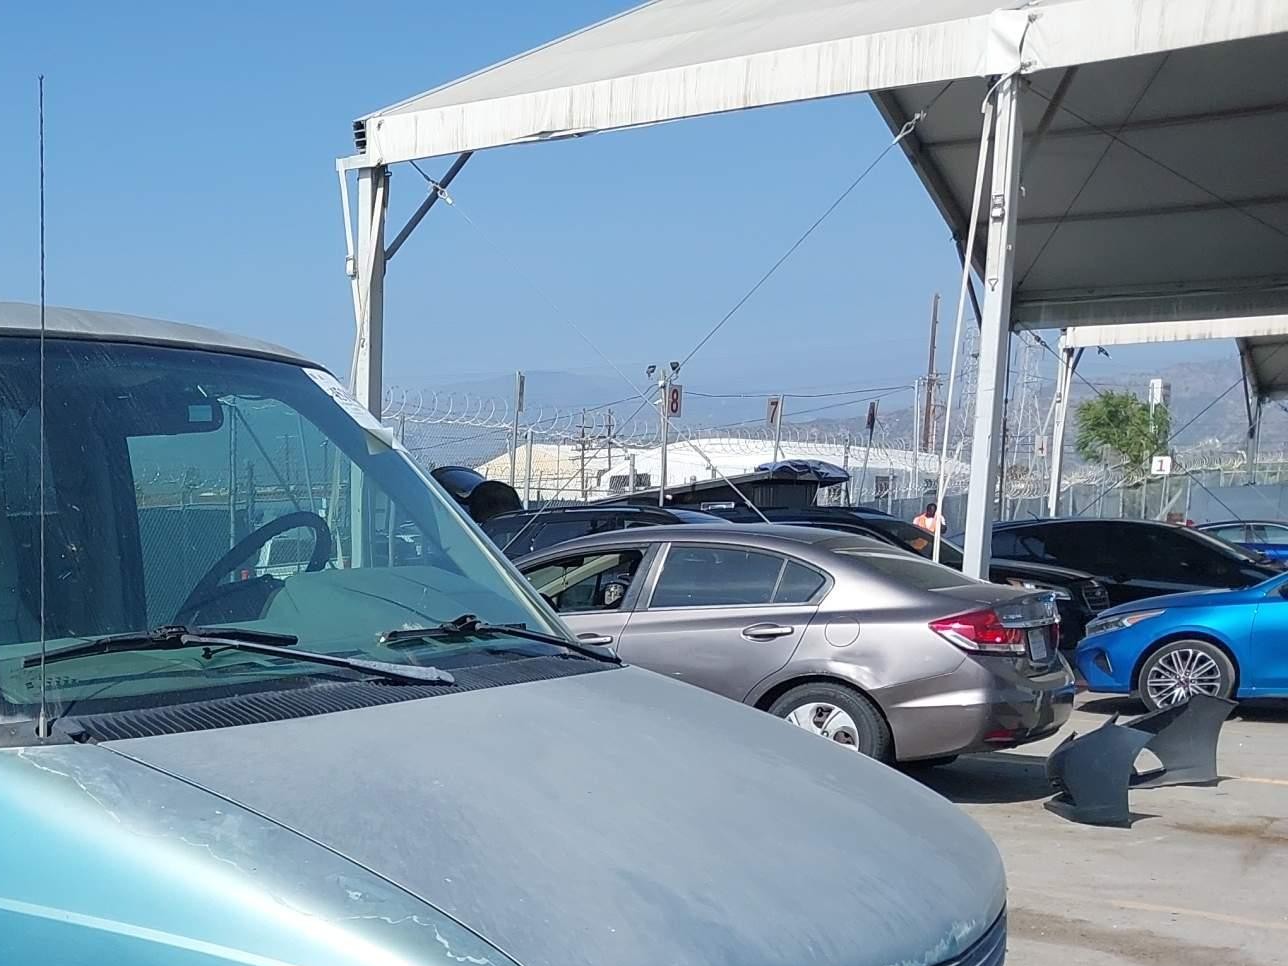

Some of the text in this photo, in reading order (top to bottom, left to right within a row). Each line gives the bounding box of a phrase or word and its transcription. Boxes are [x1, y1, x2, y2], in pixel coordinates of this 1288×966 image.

[670, 388, 679, 413] 8
[770, 400, 779, 423] 7
[1156, 459, 1166, 472] 1
